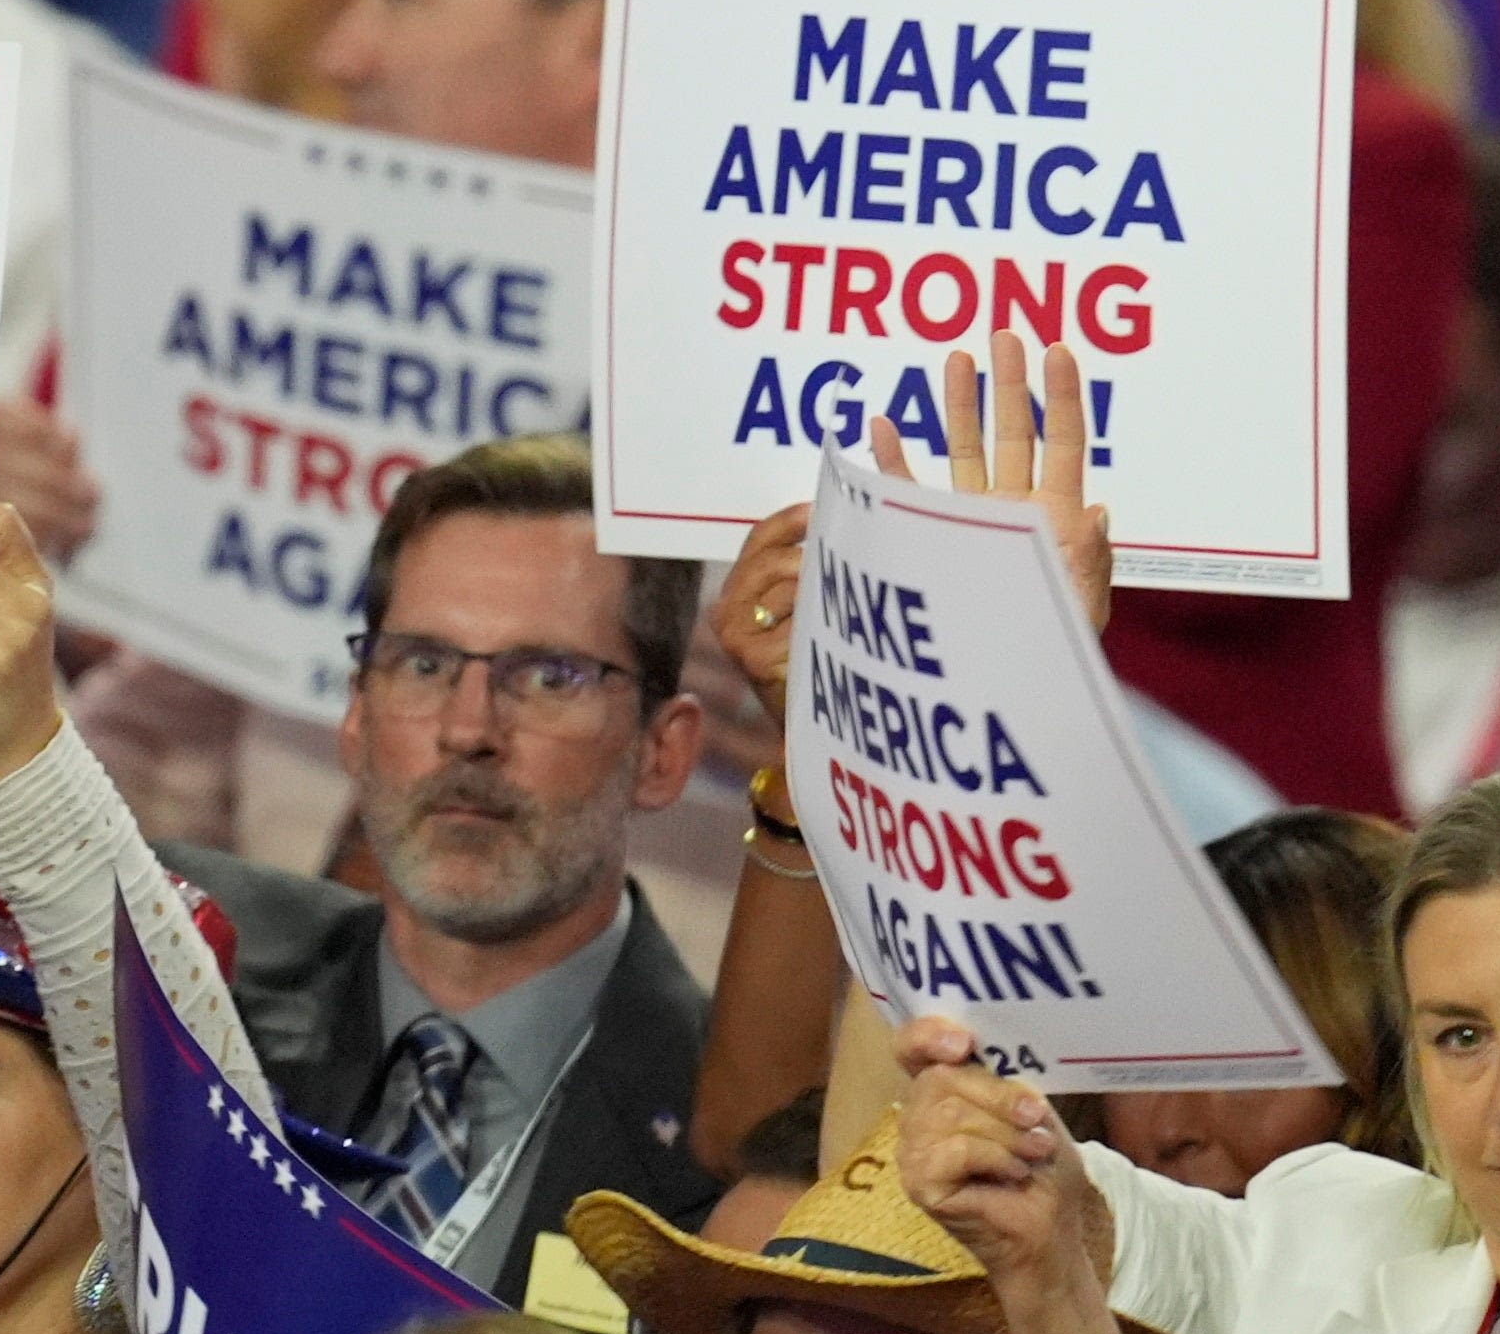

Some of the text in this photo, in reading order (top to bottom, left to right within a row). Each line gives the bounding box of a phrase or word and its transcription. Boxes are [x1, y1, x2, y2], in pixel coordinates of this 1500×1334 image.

[794, 14, 1091, 120] MAKE
[703, 125, 1185, 243] AMERICA
[242, 207, 551, 354] MAKE
[716, 239, 1152, 355] STRONG
[162, 281, 592, 446] AMERIC
[182, 389, 438, 518] STRO
[207, 506, 369, 618] AGA
[817, 537, 944, 678] MAKE
[810, 638, 1047, 798] AMERICA
[829, 757, 1073, 902] STRONG
[866, 883, 1103, 1003] AGAIN!
[972, 1044, 1047, 1079] 24
